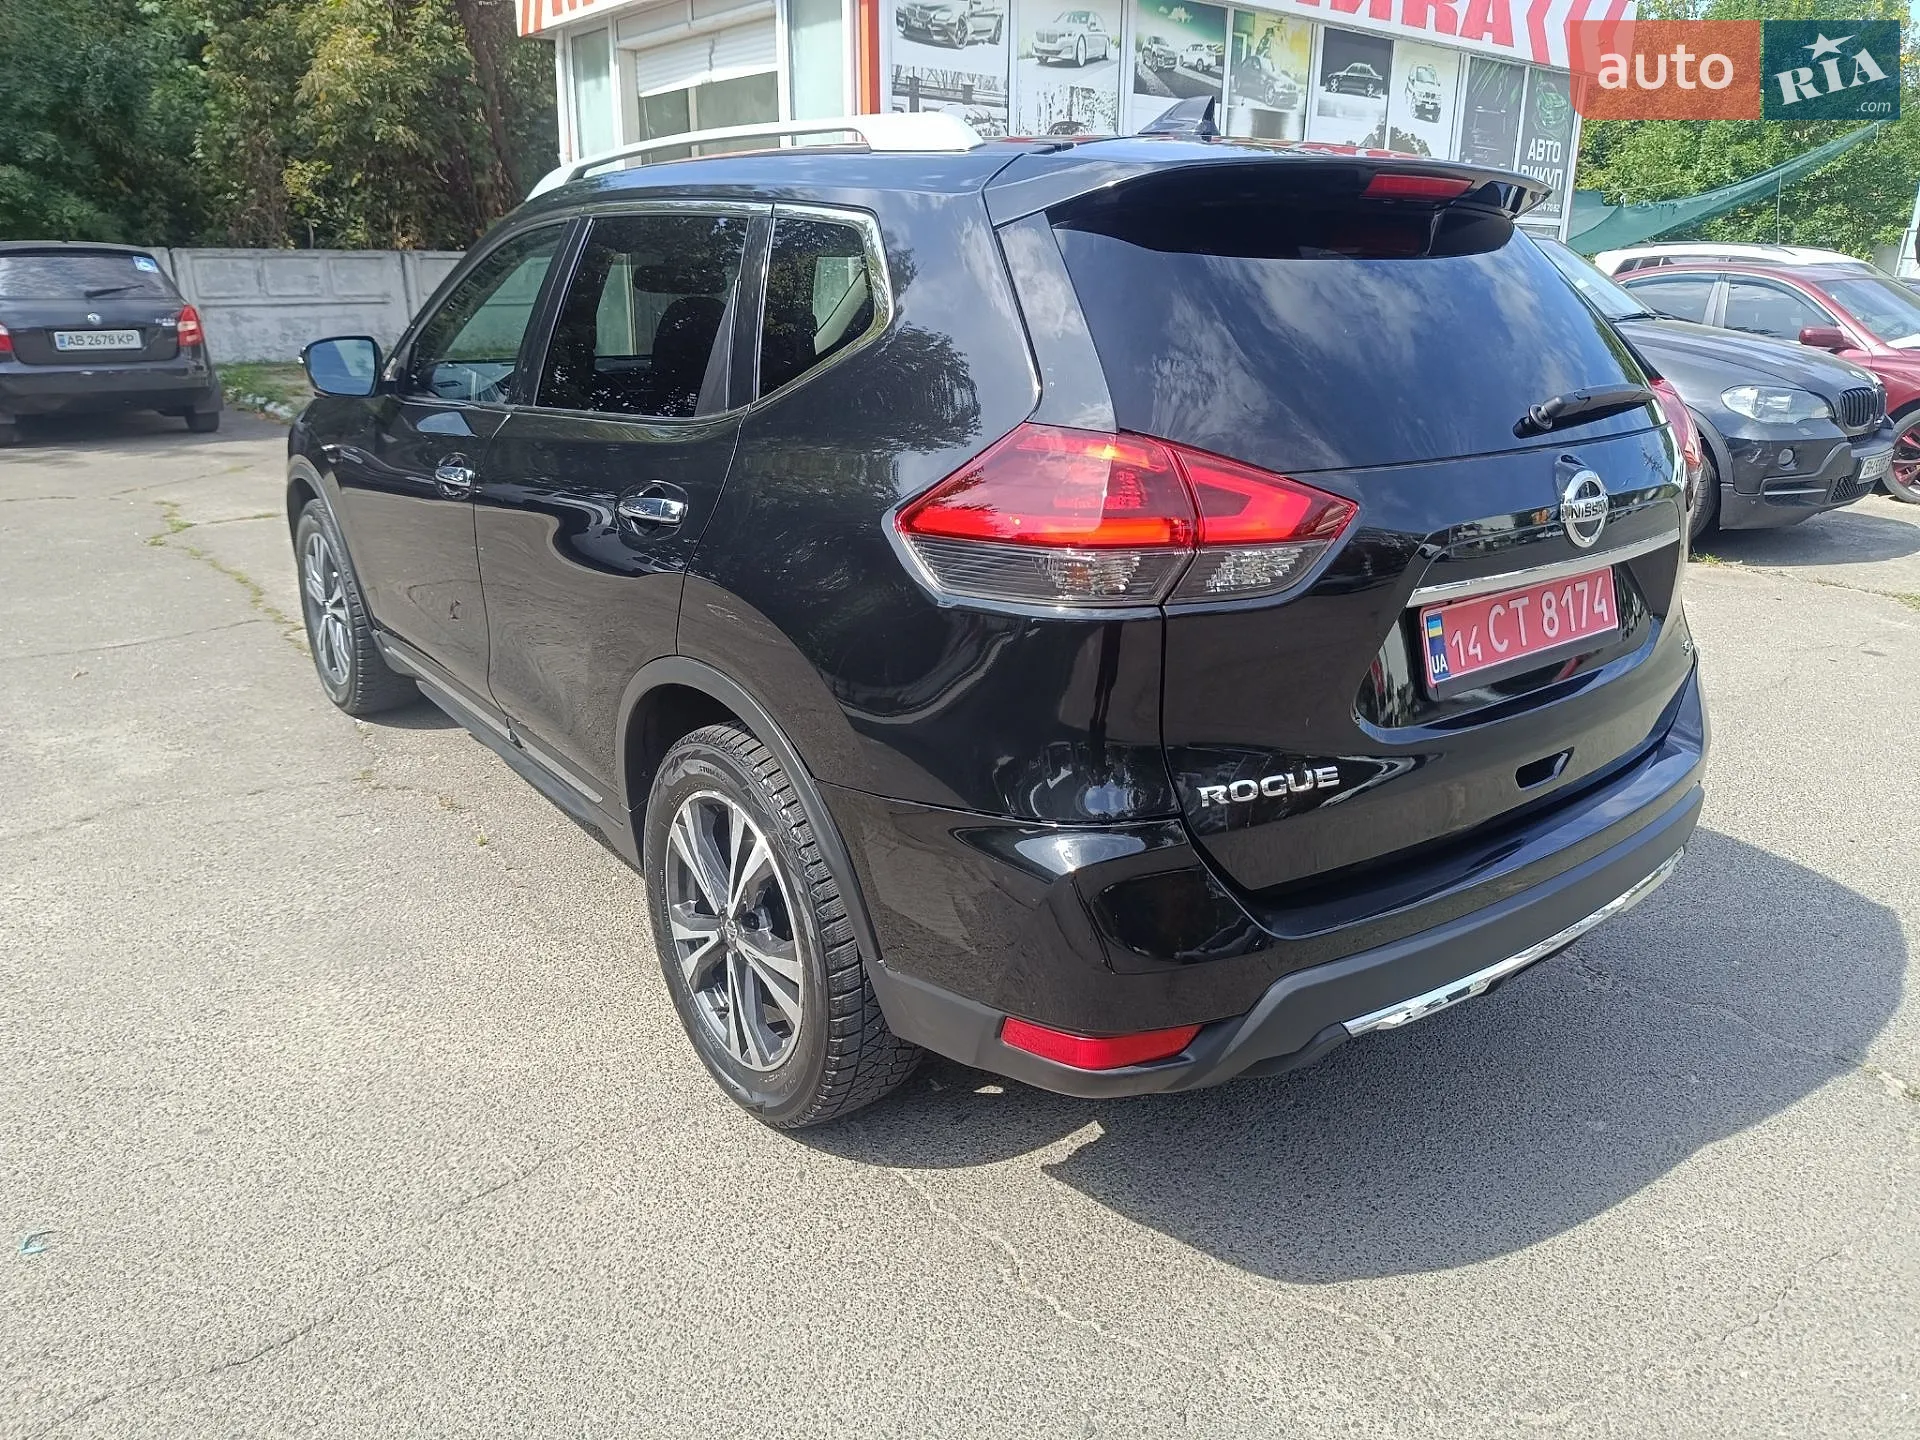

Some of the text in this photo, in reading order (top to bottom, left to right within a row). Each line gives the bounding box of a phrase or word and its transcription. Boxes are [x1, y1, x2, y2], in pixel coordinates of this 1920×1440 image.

[1527, 138, 1561, 163] АВТО
[68, 334, 134, 346] AB 2678 KP
[1451, 576, 1609, 667] 14 CT 8174
[1431, 653, 1449, 674] UA
[1196, 765, 1340, 807] ROGUE
